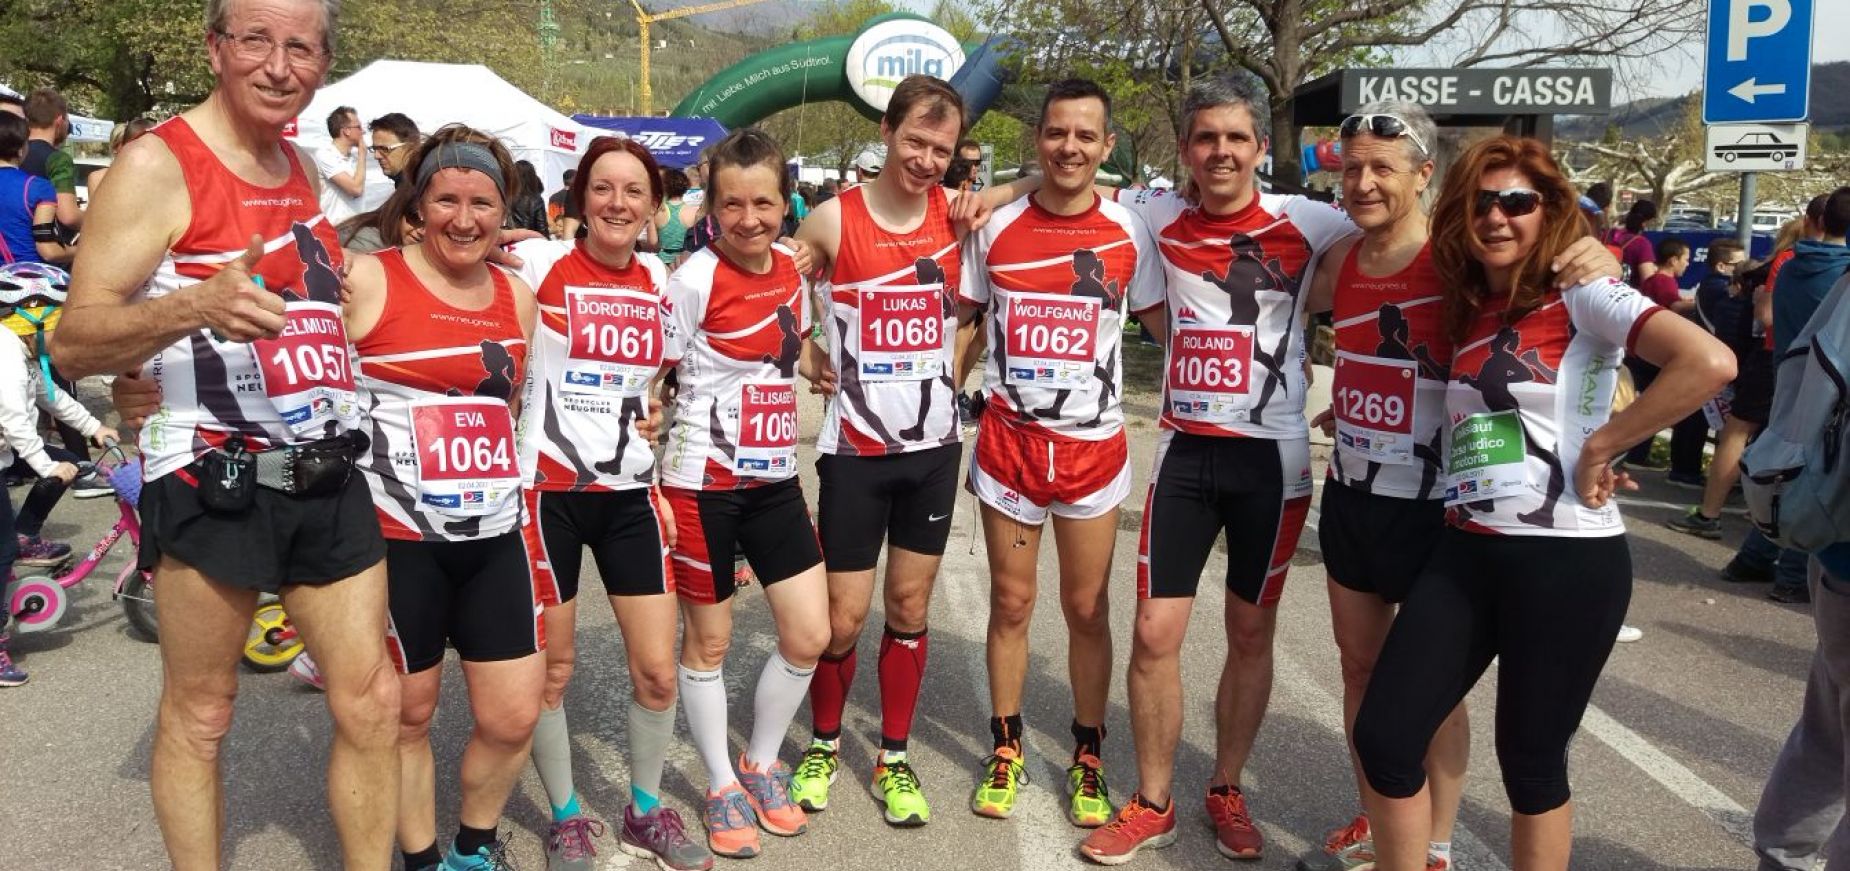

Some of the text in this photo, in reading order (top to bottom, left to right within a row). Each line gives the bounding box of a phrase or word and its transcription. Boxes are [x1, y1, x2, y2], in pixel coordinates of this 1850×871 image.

[1727, 0, 1792, 62] P
[878, 48, 943, 77] mila
[702, 99, 719, 113] mit
[744, 69, 771, 87] Milch
[772, 64, 791, 76] aus
[1359, 76, 1458, 105] KASSE
[1493, 76, 1596, 106] CASSA
[883, 298, 927, 311] LUKAS
[1015, 304, 1094, 322] WOLFGANG
[280, 316, 339, 338] ELMUTH
[581, 322, 654, 361] 1061
[869, 316, 938, 347] 1068
[1015, 324, 1090, 356] 1062
[1183, 336, 1234, 351] ROLAND
[272, 344, 347, 385] 1057
[1176, 356, 1242, 387] 1063
[564, 404, 612, 414] NEUGRIES
[751, 389, 794, 405] ELISABE
[1337, 386, 1405, 427] 1269
[454, 412, 486, 427] EVA
[749, 412, 796, 443] 1066
[429, 437, 511, 472] 1064
